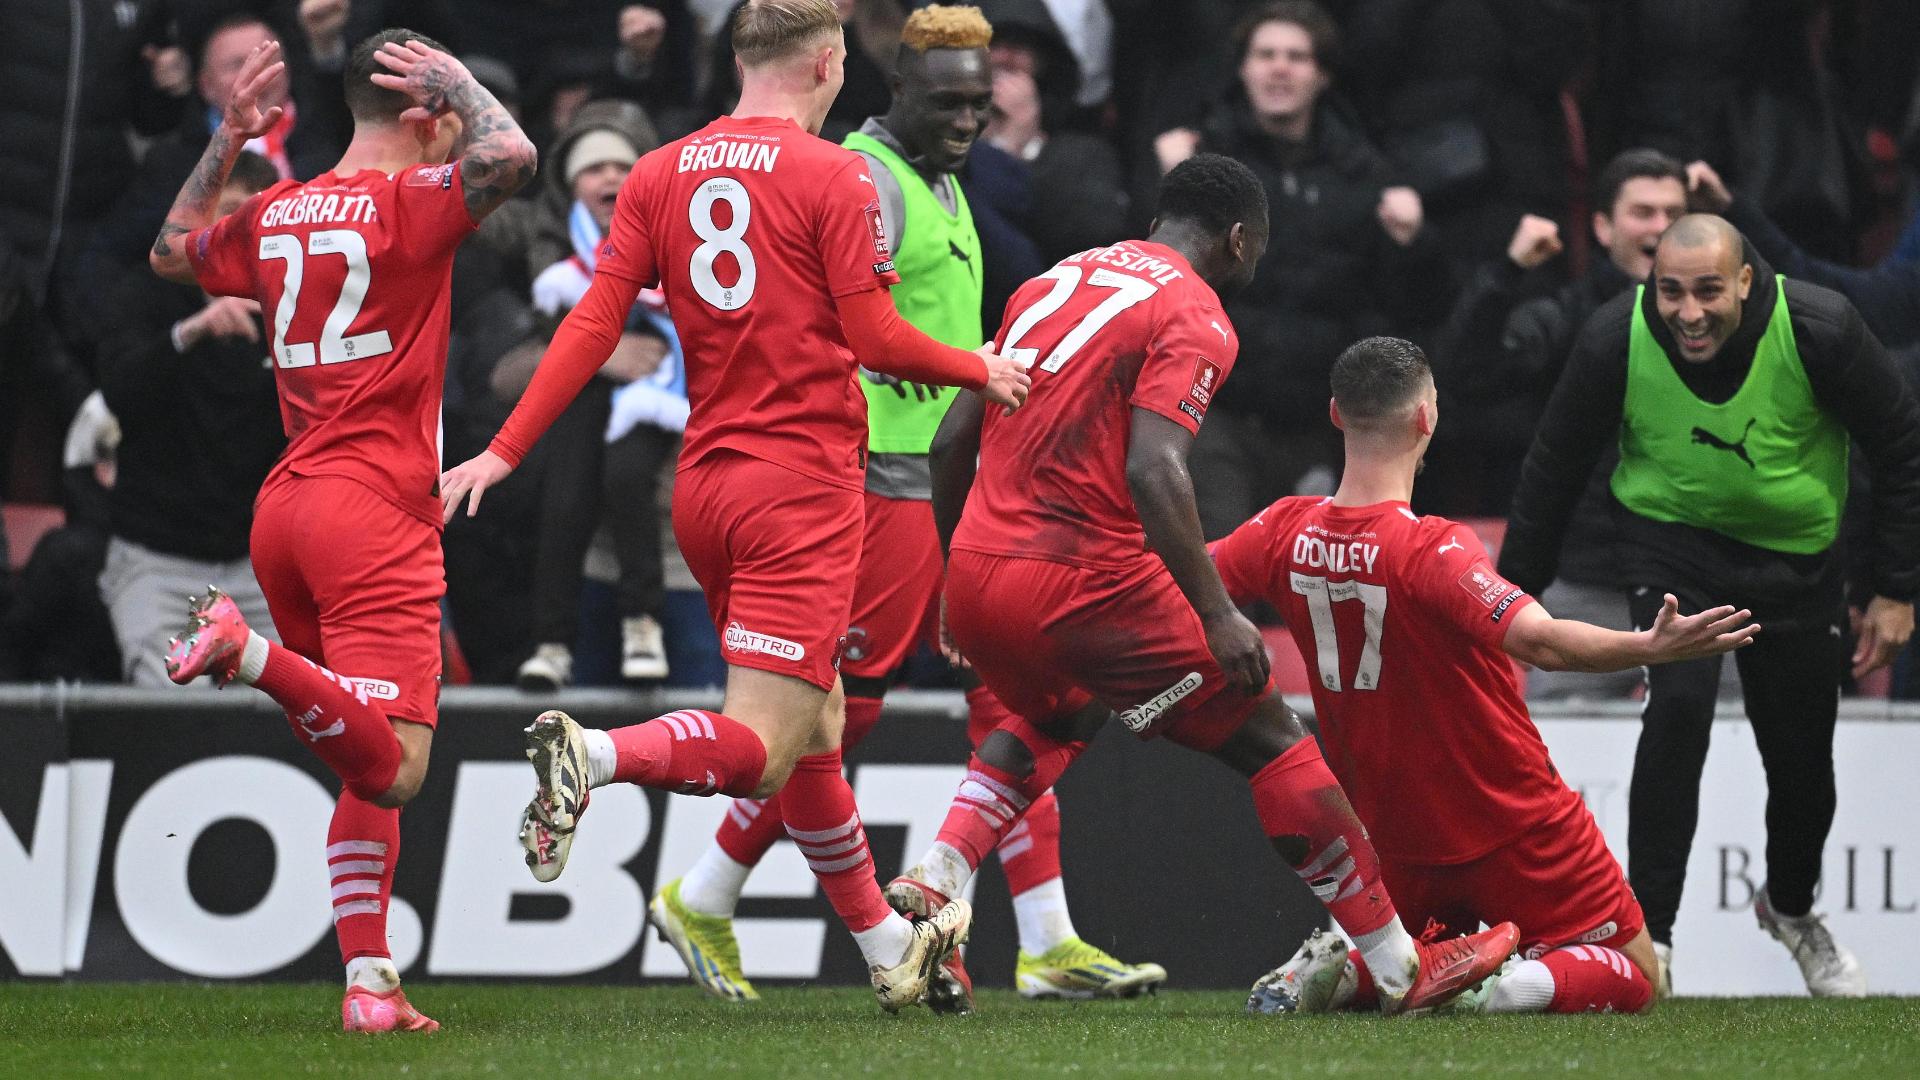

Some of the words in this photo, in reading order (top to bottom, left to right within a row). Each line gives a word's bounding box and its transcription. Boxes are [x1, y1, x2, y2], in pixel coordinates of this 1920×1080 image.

[678, 141, 780, 173] BROWN
[689, 176, 757, 311] 8
[259, 229, 393, 368] 22
[1000, 265, 1159, 374] 27
[1293, 533, 1380, 574] DONLEY
[1485, 594, 1497, 603] FA
[1494, 584, 1508, 596] CUP
[726, 629, 797, 656] QUATTRO
[1290, 571, 1388, 692] 17
[1717, 847, 1919, 912] BIL
